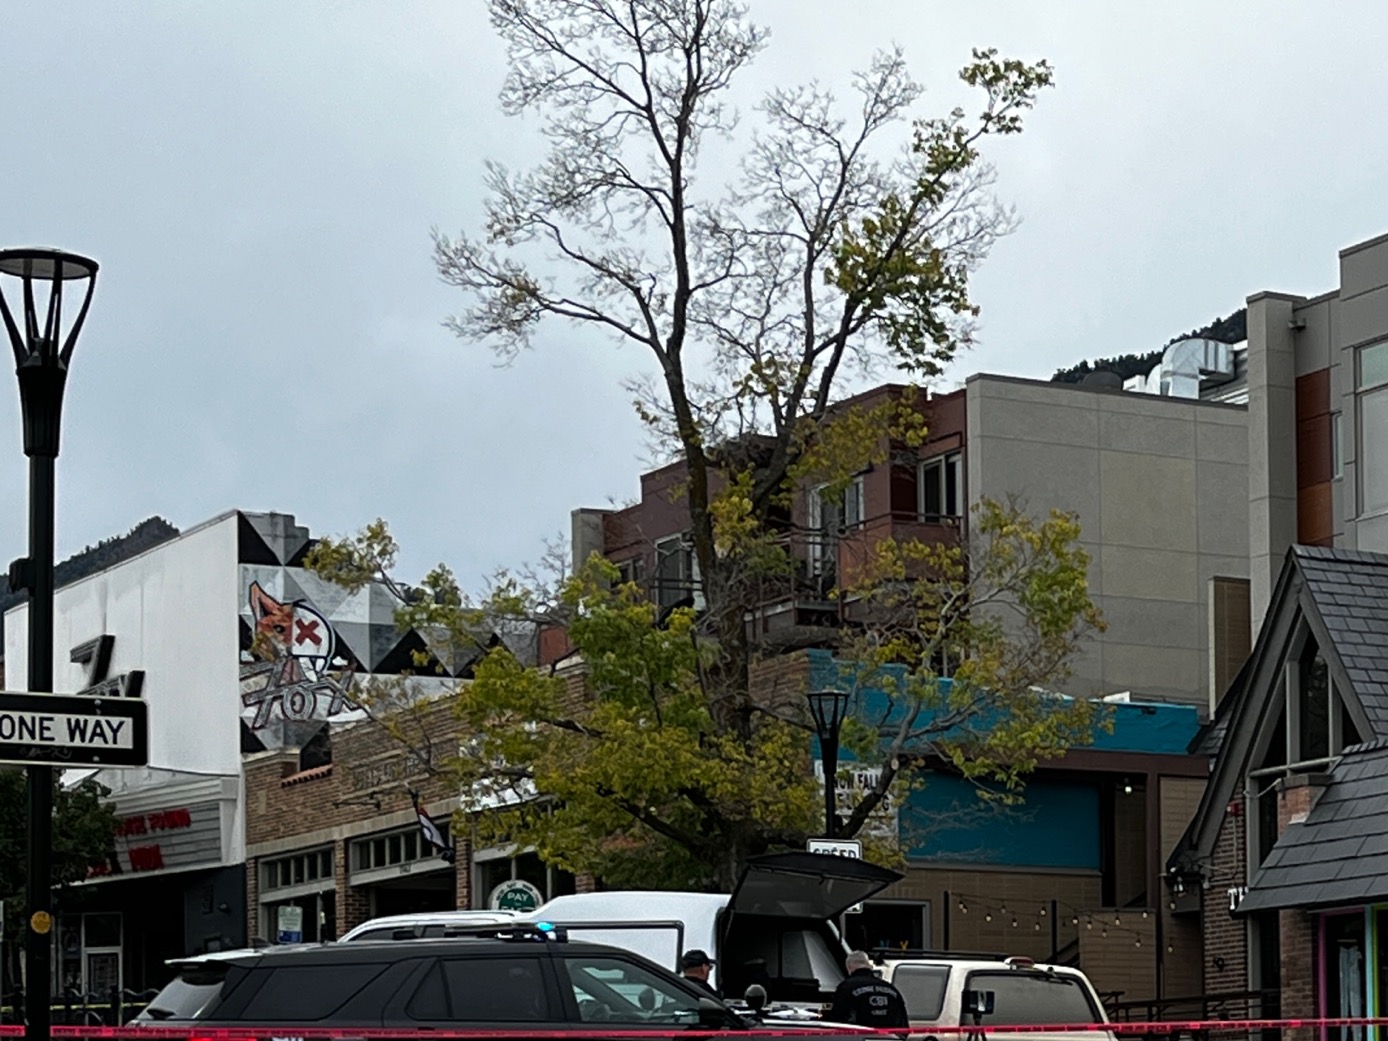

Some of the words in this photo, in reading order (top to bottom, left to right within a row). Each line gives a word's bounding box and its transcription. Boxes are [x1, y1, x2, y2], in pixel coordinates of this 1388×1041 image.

[0, 714, 55, 741] ONE
[66, 717, 125, 745] WAY
[507, 892, 529, 901] PAY
